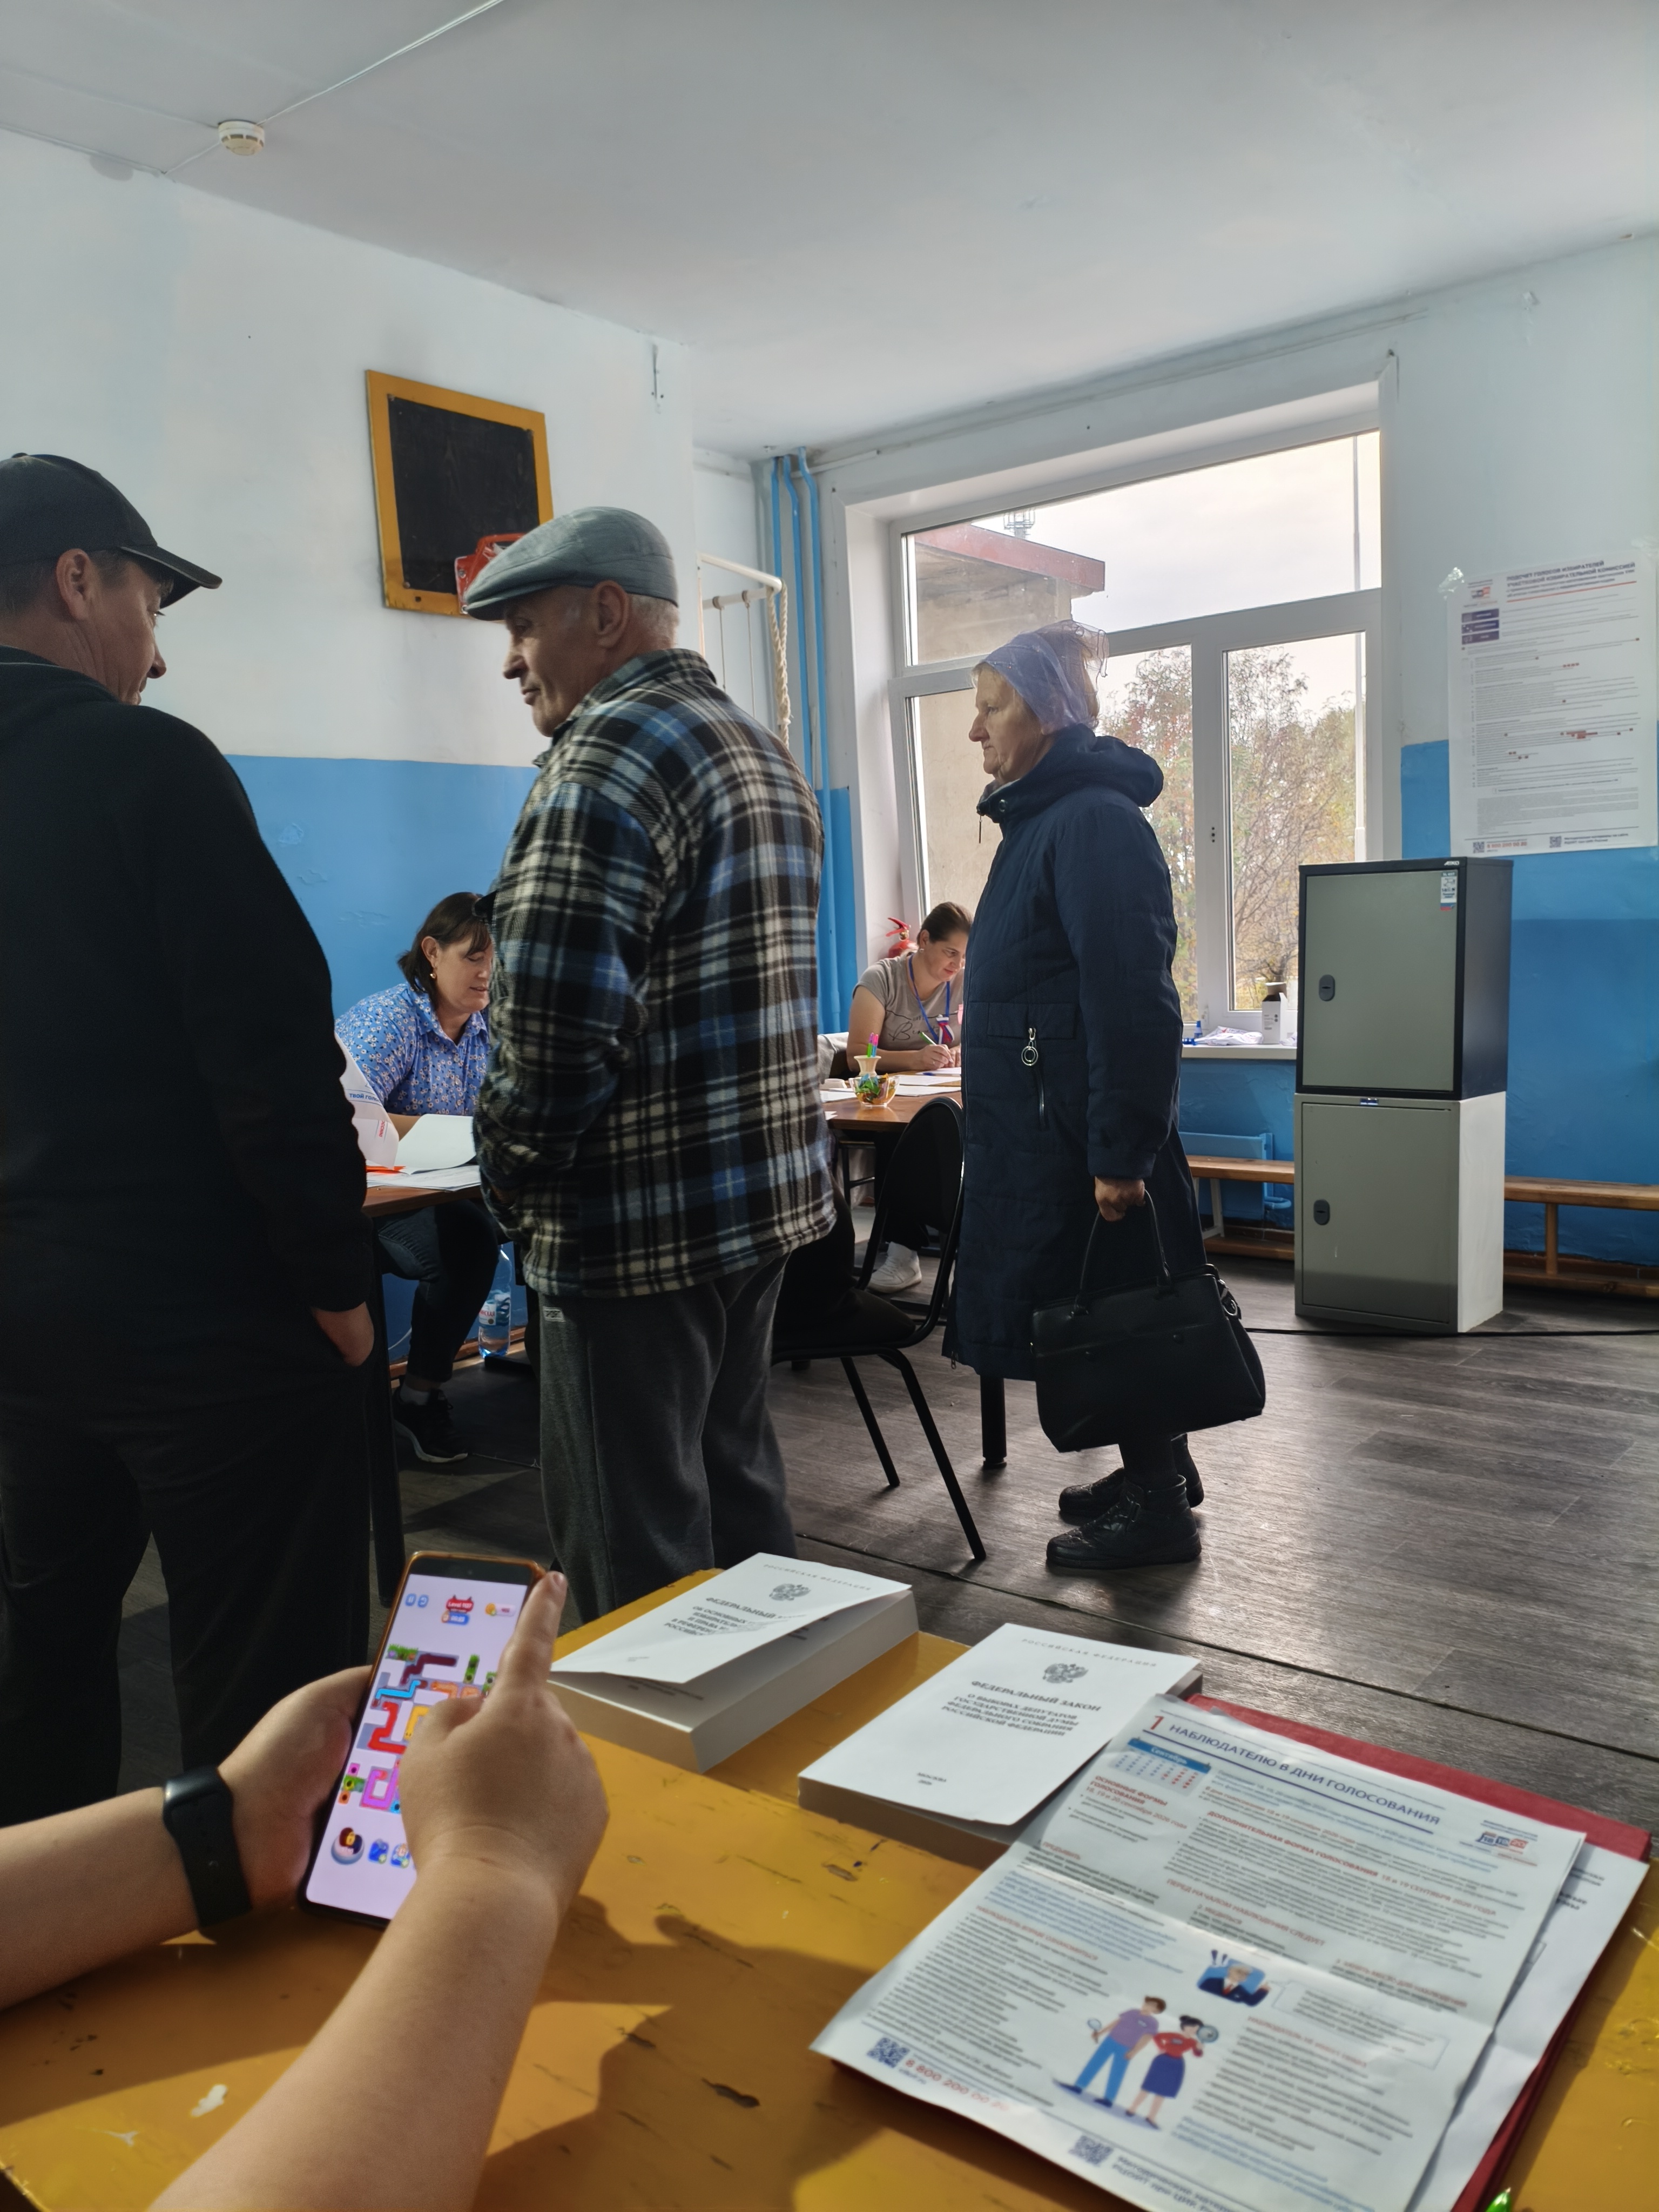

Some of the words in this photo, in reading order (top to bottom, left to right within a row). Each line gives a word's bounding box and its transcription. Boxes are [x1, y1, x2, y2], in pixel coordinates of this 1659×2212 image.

[764, 1564, 817, 1579] РОССИЙСКАЯ
[820, 1576, 871, 1590] ФЕДЕРАЦИЯ
[706, 1597, 777, 1618] ФЕДЕРАЛЬНЫЙ
[1022, 1638, 1089, 1655] РОССИЙСКАЯ
[1093, 1653, 1157, 1667] ФЕДЕРАЦИЯ
[970, 1680, 1060, 1704] ФЕДЕРАЛЬНЫЙ
[1060, 1700, 1101, 1711] ЗАКОН
[976, 1695, 1021, 1709] ВЫБОРАХ
[1021, 1705, 1077, 1719] ДЕПУТАТОВ
[941, 1705, 1006, 1725] РОССИЙСКОЙ
[1007, 1722, 1065, 1736] ФЕДЕРАЦИИ
[947, 1701, 1021, 1721] ФЕДЕРАЛЬНОГО
[1022, 1717, 1074, 1731] СОБРАНИЯ
[953, 1696, 1046, 1721] ГОСУДАРСТВЕННОЙ
[1047, 1716, 1079, 1727] ДУМЫ
[1150, 1715, 1164, 1730] 1
[1151, 1747, 1188, 1765] Сентябрь
[1170, 1724, 1277, 1768] НАБЛЮДАТЕЛЮ
[1279, 1763, 1289, 1771] В
[1290, 1768, 1324, 1784] ДНИ
[1326, 1779, 1441, 1825] ГОЛОСОВАНИЯ
[1090, 1781, 1145, 1805] ГОЛОСОВАНИЯ
[1095, 1775, 1136, 1793] ОСНОВНЫЕ
[1137, 1790, 1168, 1806] ФОРМЫ
[1208, 1811, 1283, 1843] ДОПОЛНИТЕЛЬНАЯ
[1284, 1839, 1314, 1854] ФОРМА
[1315, 1850, 1379, 1877] ГОЛОСОВАНИЯ
[1166, 1878, 1191, 1893] ПЕРЕД
[1191, 1887, 1232, 1909] НАЧАЛОМ
[1232, 1903, 1289, 1932] НАБЛЮДЕНИЯ
[1289, 1927, 1326, 1946] СЛЕДУЕТ
[906, 2059, 915, 2067] 8
[916, 2065, 941, 2081] 800
[942, 2079, 969, 2094] 200
[972, 2092, 989, 2103] 00
